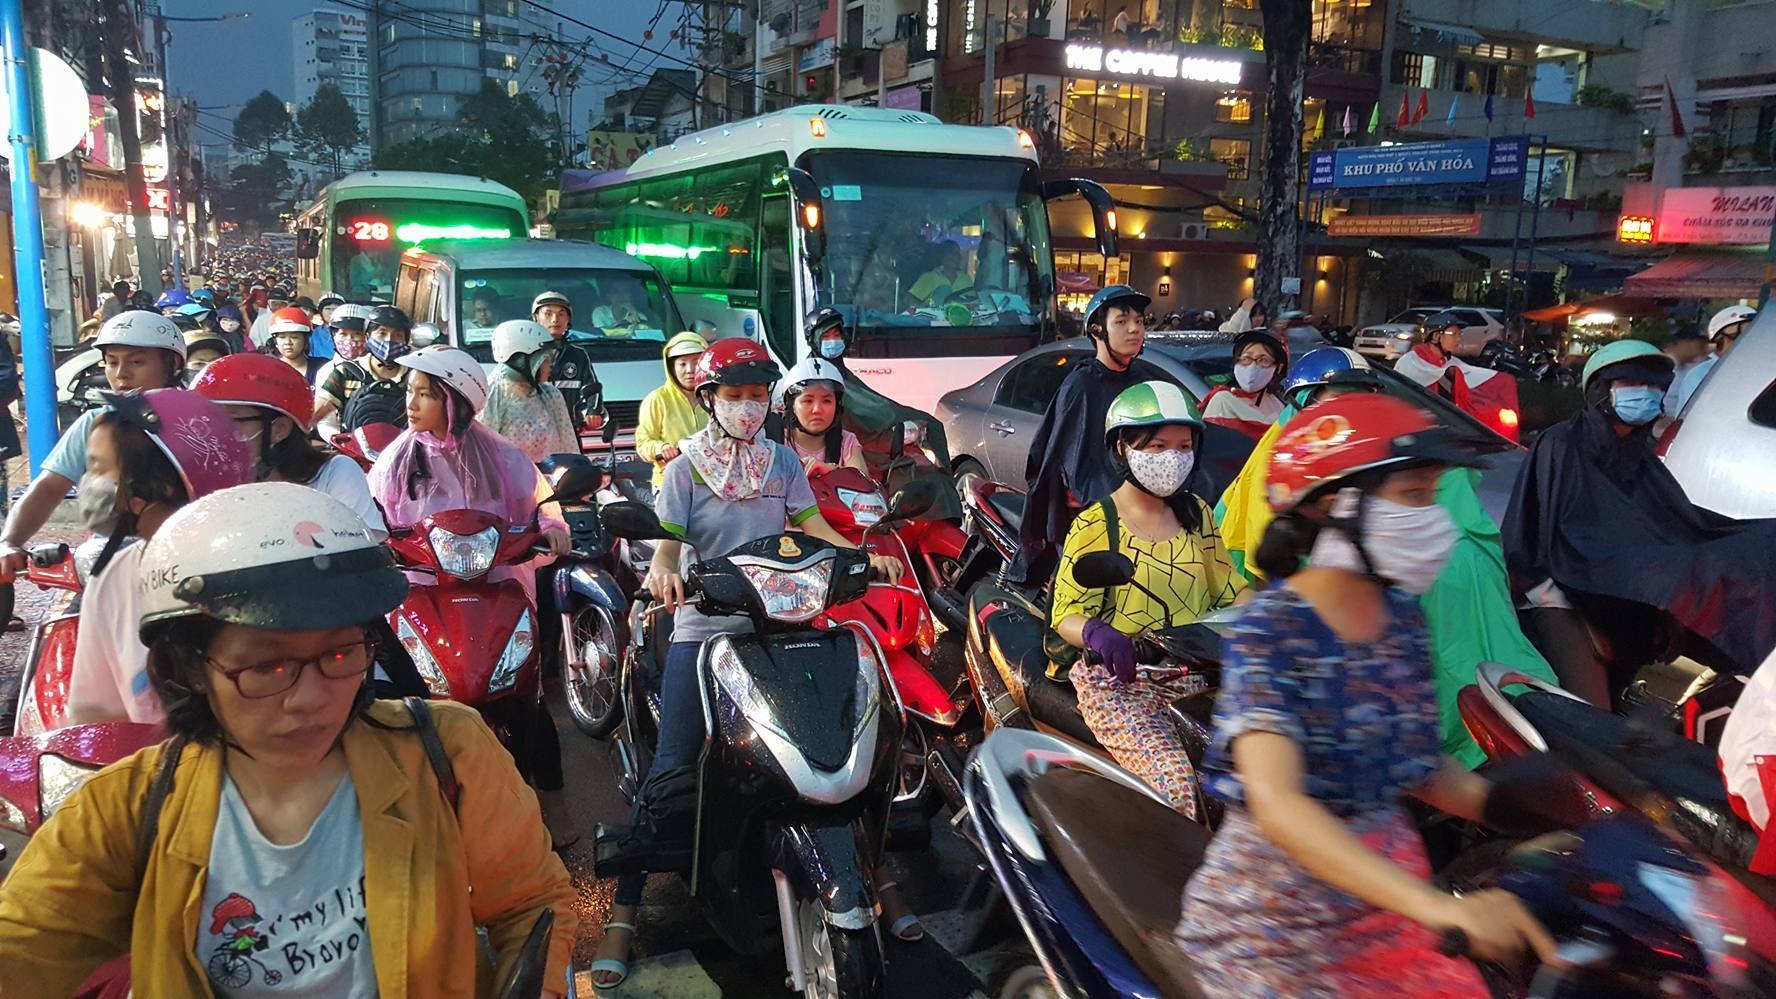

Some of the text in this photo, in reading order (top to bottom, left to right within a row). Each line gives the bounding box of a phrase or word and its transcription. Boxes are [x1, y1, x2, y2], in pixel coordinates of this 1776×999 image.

[1344, 164, 1373, 176] KHU
[1376, 157, 1405, 174] PHỐ
[1408, 158, 1438, 172] VĂN
[1441, 154, 1474, 171] HÓA
[354, 222, 389, 241] 28
[784, 641, 821, 650] HONDA
